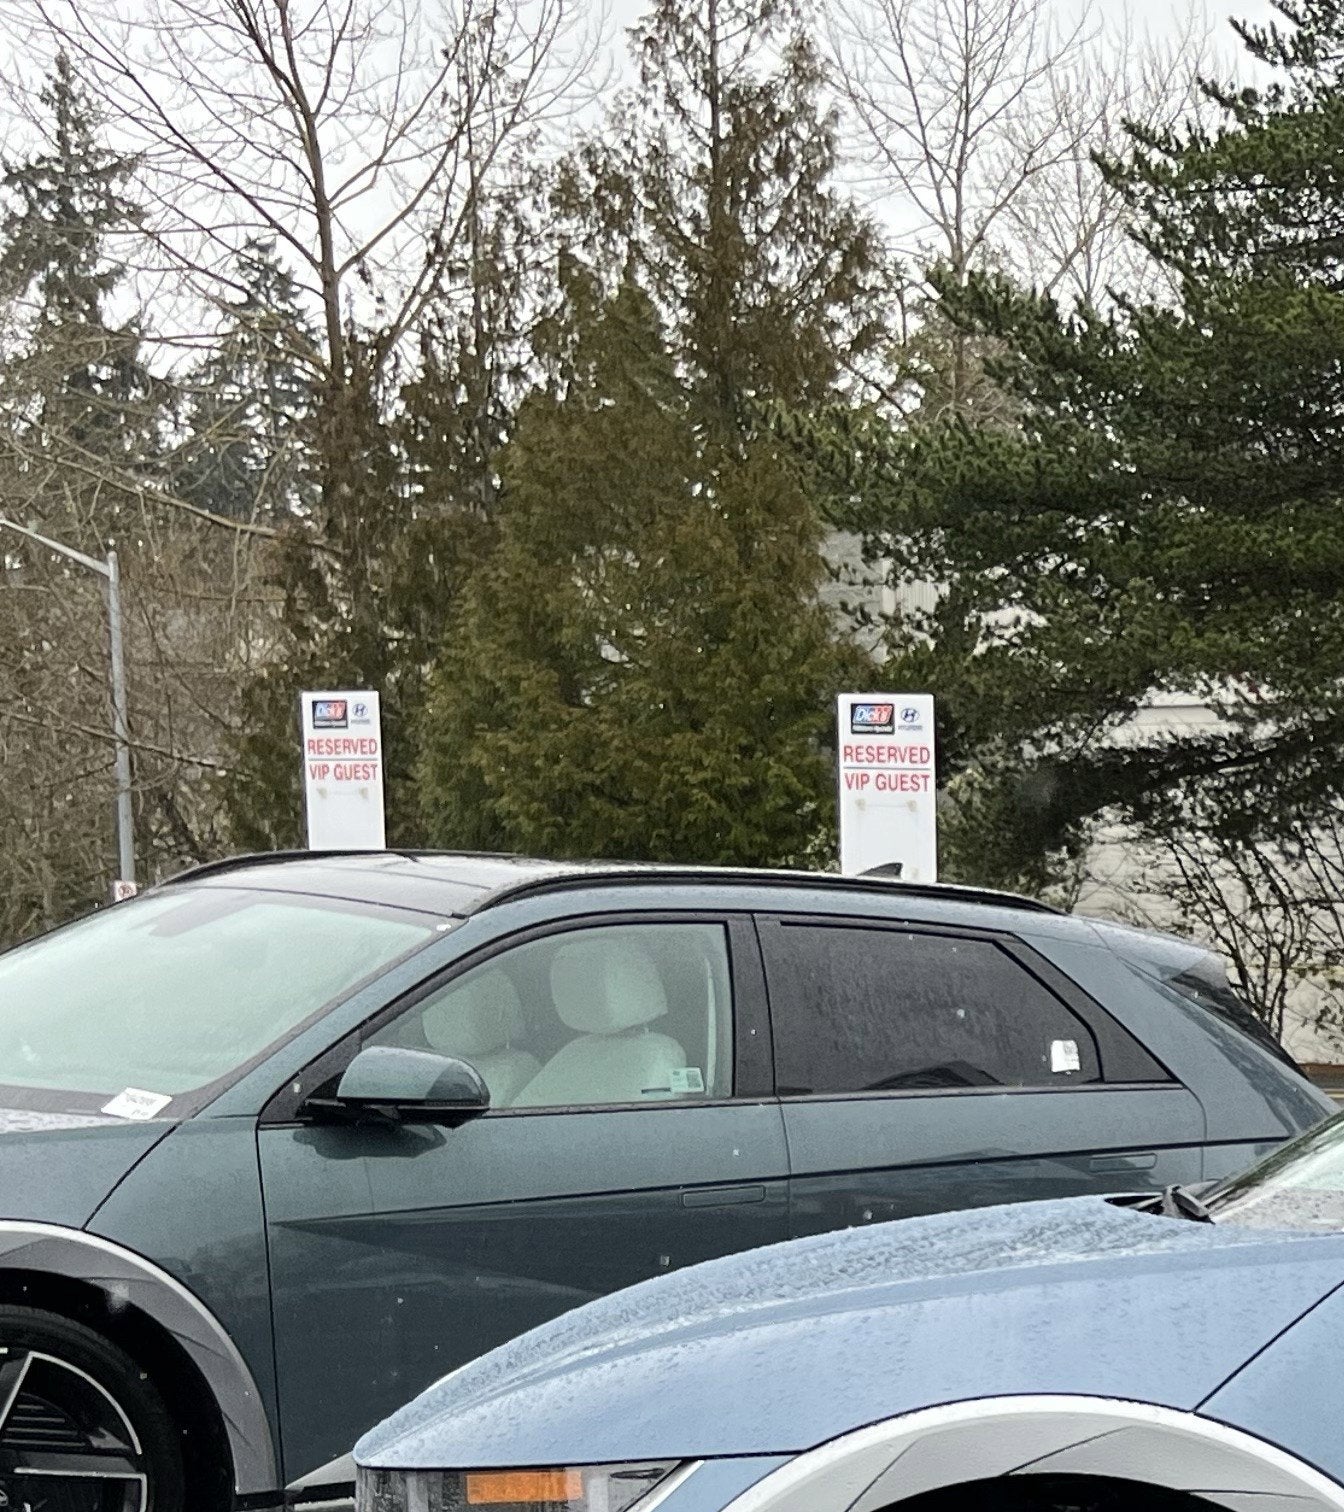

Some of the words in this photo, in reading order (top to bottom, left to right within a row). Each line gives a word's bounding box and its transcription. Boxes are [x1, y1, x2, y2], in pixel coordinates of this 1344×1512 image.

[308, 739, 377, 755] RESERVED
[845, 746, 930, 764] RESERVED
[311, 765, 329, 780] VIP
[335, 765, 377, 780] GUEST
[845, 774, 869, 790] VIP
[876, 775, 929, 791] GUEST
